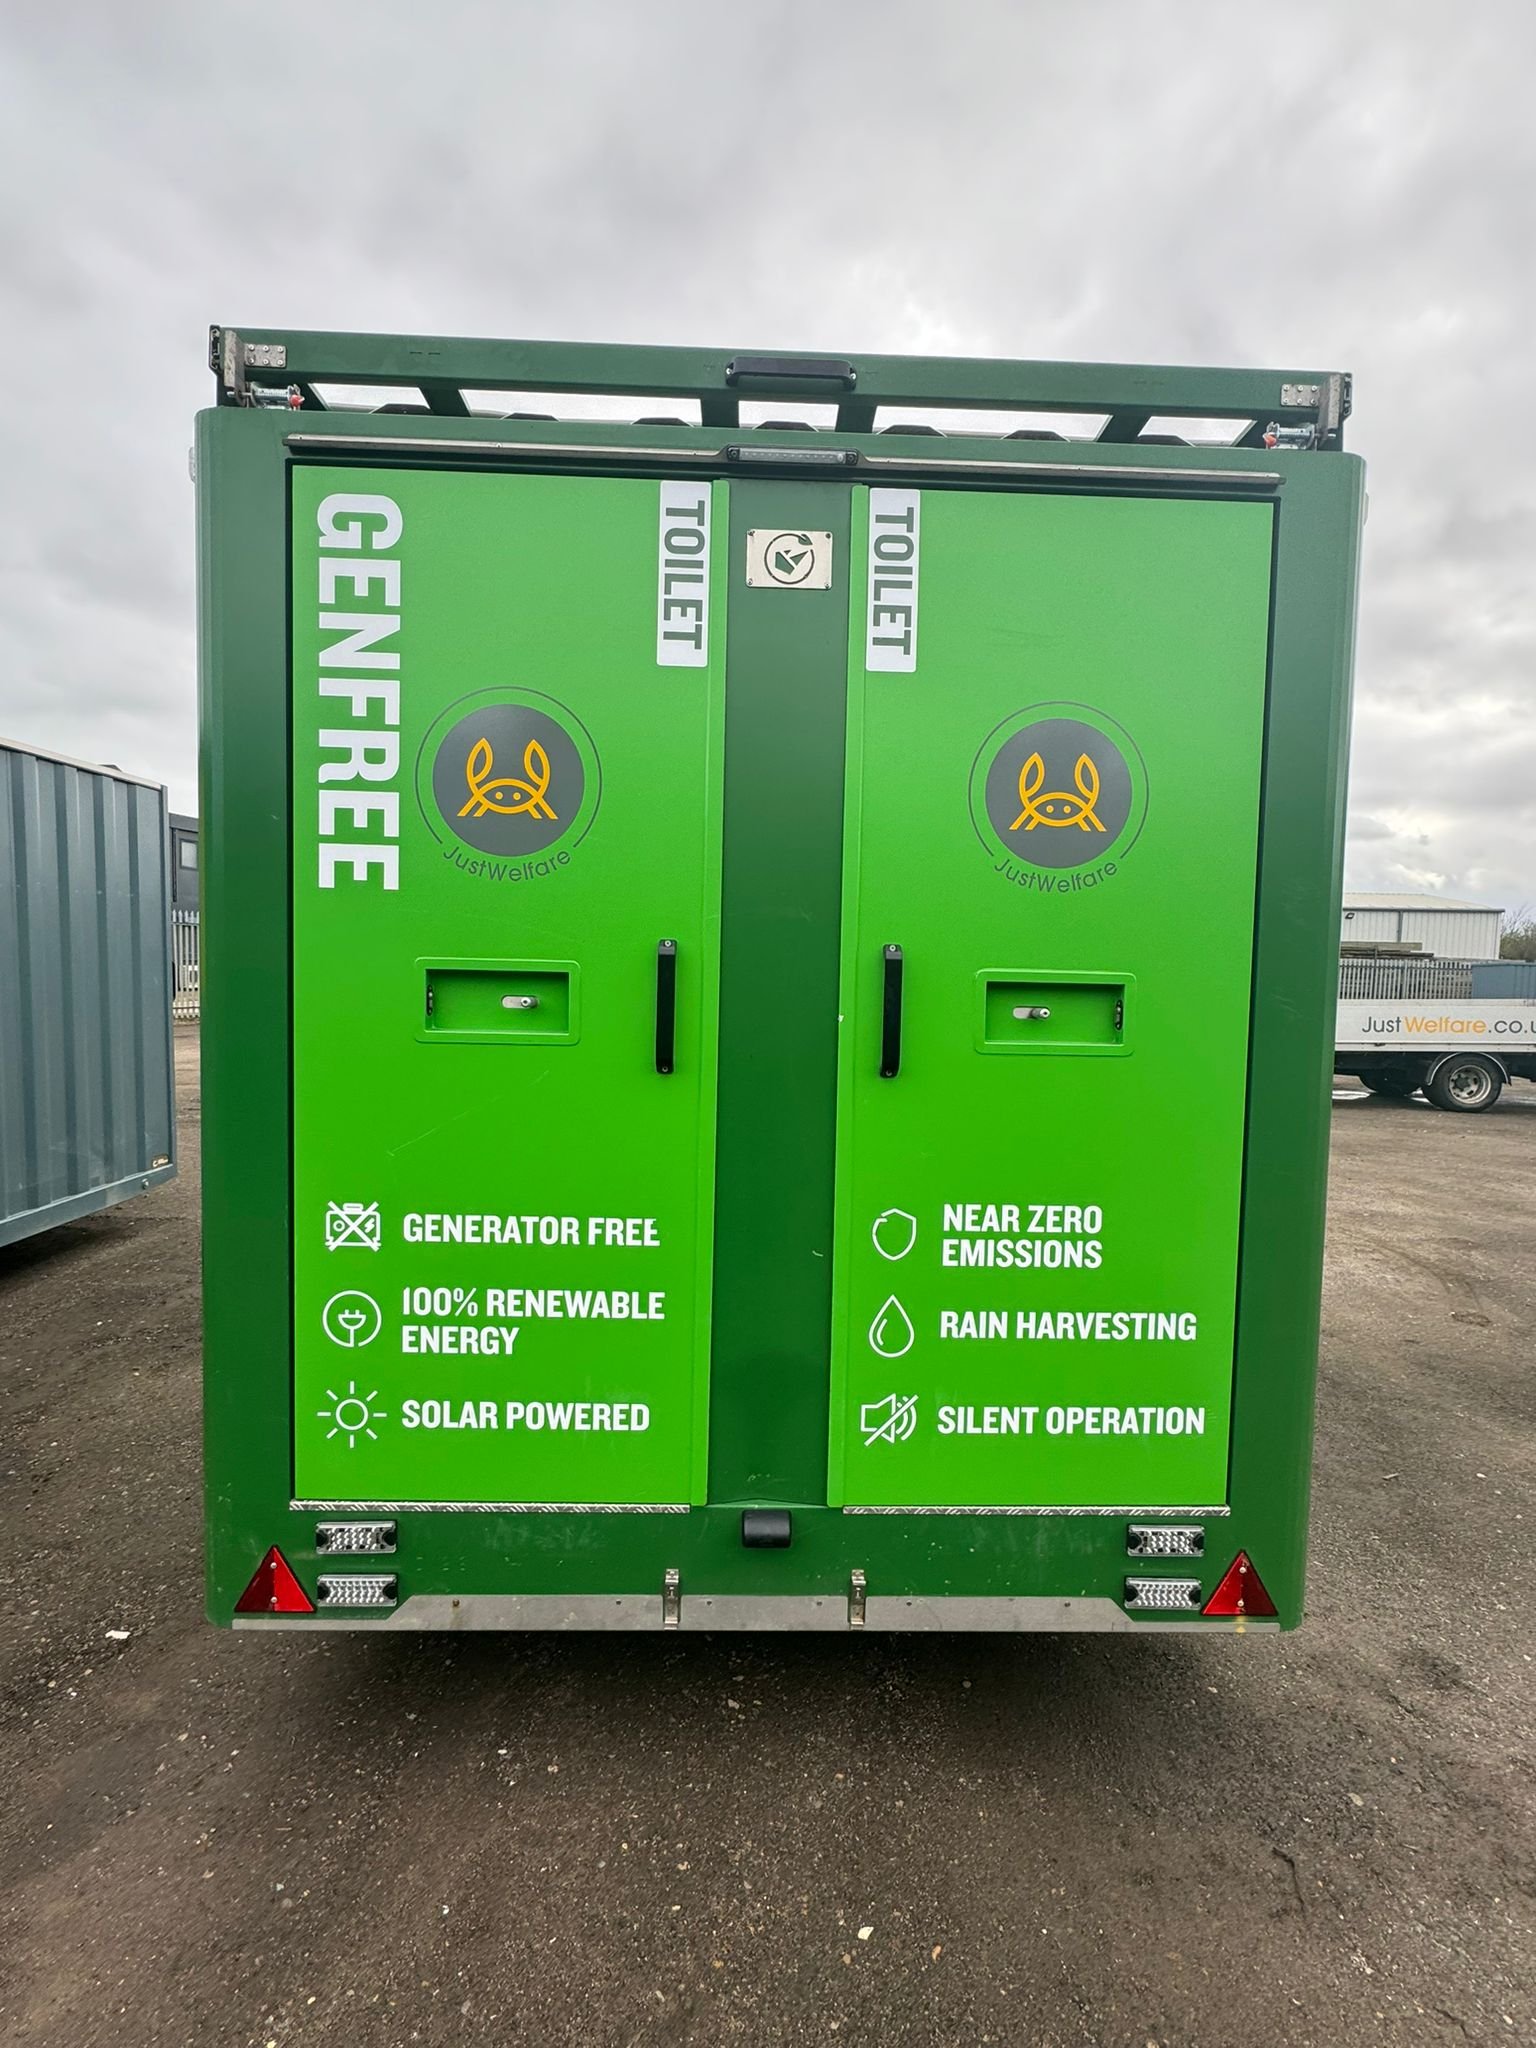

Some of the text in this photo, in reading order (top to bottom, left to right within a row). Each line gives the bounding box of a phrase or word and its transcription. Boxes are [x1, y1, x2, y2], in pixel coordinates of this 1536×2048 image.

[664, 500, 706, 650] TOILET
[873, 507, 915, 656] TOILET
[317, 493, 402, 890] GENFREE
[443, 846, 571, 881] JustWelfare
[995, 858, 1118, 893] JustWelfare
[403, 1213, 660, 1247] GENERATOR FREE
[943, 1203, 1103, 1234] NEAR ZERO
[942, 1239, 1103, 1269] EMISSIONS
[402, 1286, 665, 1320] 100% RENEWABLE
[402, 1325, 520, 1355] ENERGY
[940, 1311, 1197, 1341] RAIN HARVESTING
[401, 1399, 650, 1431] SOLAR POWERED
[937, 1405, 1205, 1435] SILENT OPERATION
